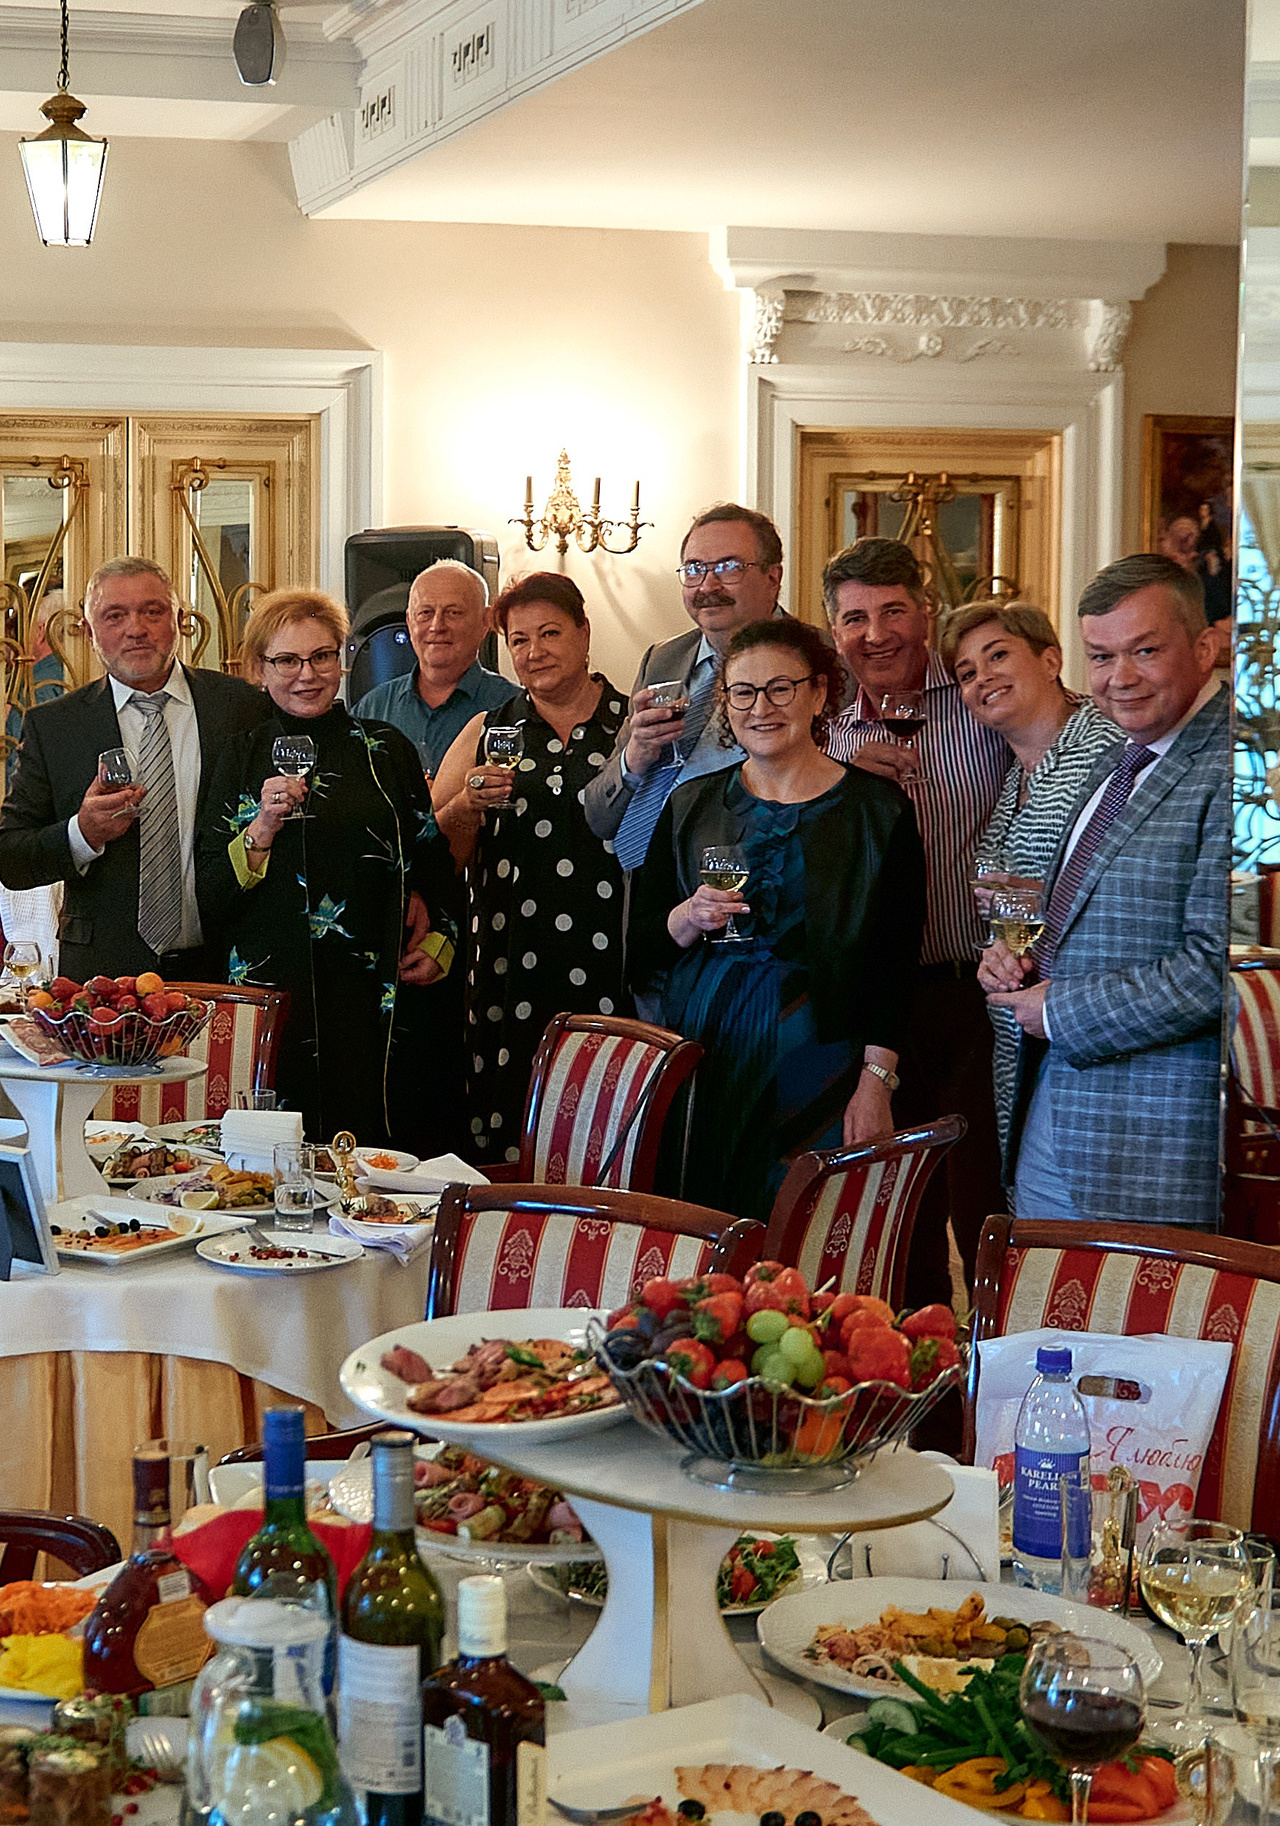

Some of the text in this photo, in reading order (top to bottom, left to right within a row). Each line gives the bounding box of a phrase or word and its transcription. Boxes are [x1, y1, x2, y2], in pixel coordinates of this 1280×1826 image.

[1090, 1425, 1202, 1471] Я люблю
[1028, 1478, 1063, 1491] PEAR
